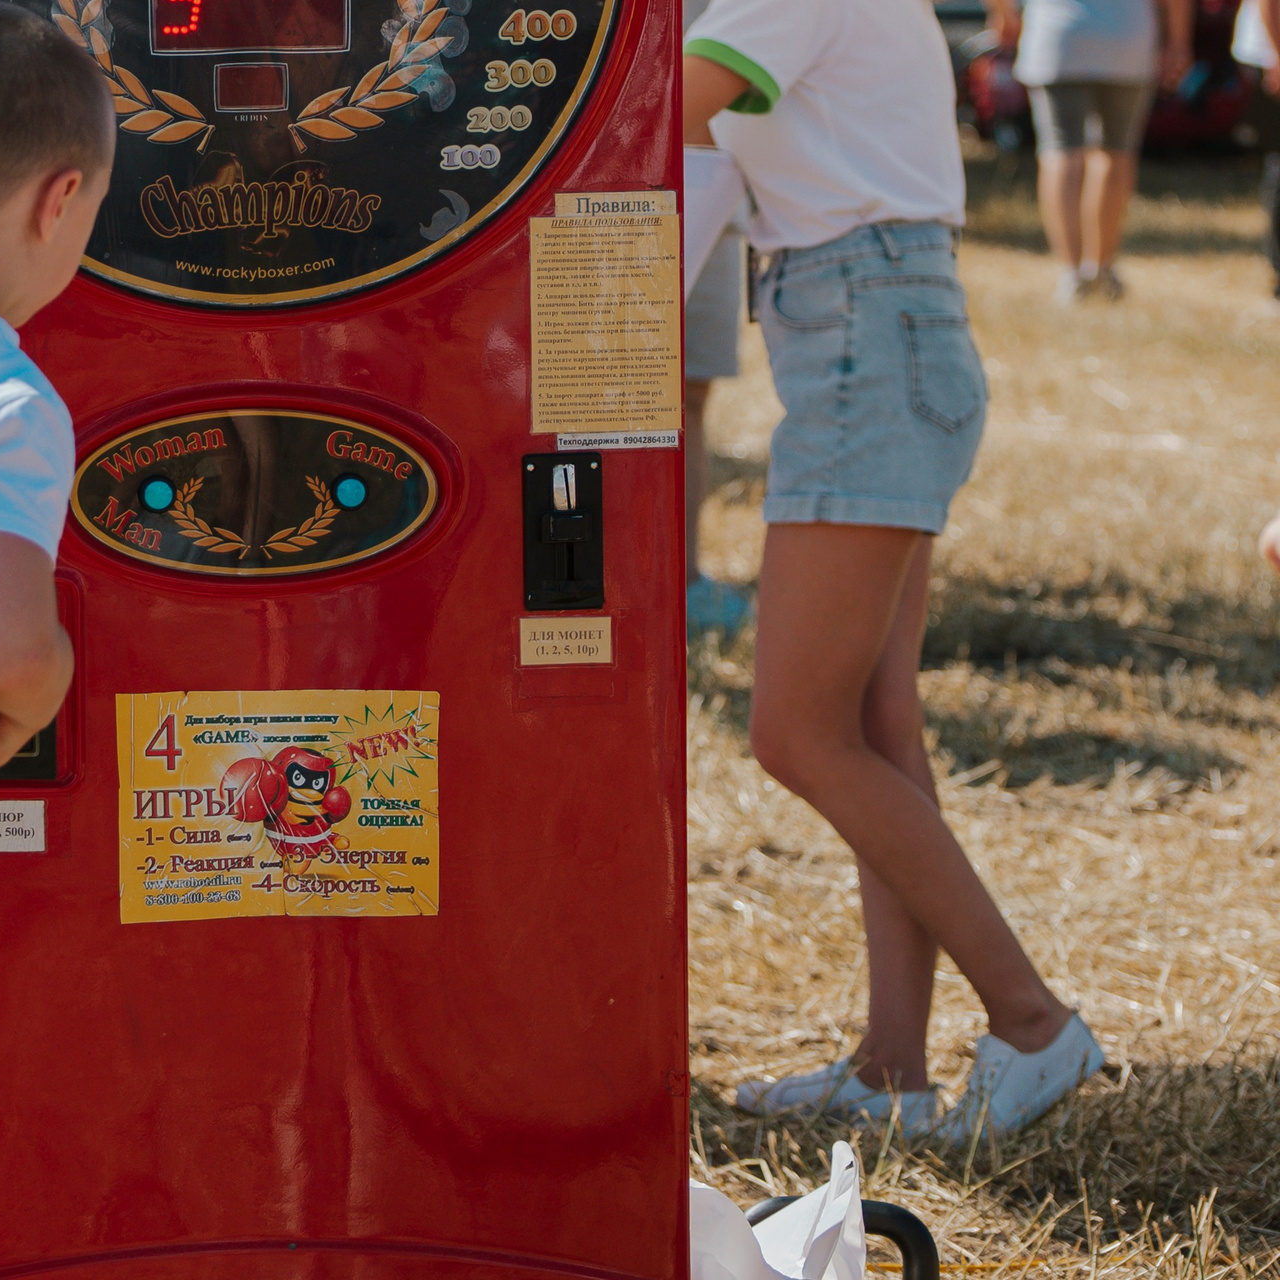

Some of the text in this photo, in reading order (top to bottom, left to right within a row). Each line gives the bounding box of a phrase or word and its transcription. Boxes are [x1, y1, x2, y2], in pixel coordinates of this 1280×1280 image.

[498, 8, 577, 45] 400
[484, 58, 556, 92] 300
[466, 105, 532, 133] 200
[440, 144, 500, 170] 100
[140, 171, 381, 238] Champions
[576, 198, 656, 216] Правила:
[175, 255, 335, 282] www.rockyboxer.com
[558, 435, 676, 447] Техподдержка 89042864330
[97, 426, 227, 483] Woman
[325, 430, 413, 481] Game
[93, 496, 163, 553] Man
[528, 630, 604, 642] ДЛЯ МОНЕТ
[536, 645, 549, 657] (1,
[552, 645, 560, 656] 2,
[564, 645, 573, 656] 5,
[145, 714, 182, 770] 4
[344, 725, 420, 763] NEW!
[133, 787, 239, 819] ИГРЫ
[360, 798, 421, 810] ТОЧНАЯ
[5, 826, 35, 839] 500р)
[358, 815, 424, 829] ОЦЕНКА!
[169, 826, 222, 845] Сила
[170, 854, 255, 874] Реакция
[321, 845, 407, 869] Энергия
[283, 874, 381, 898] Скорость
